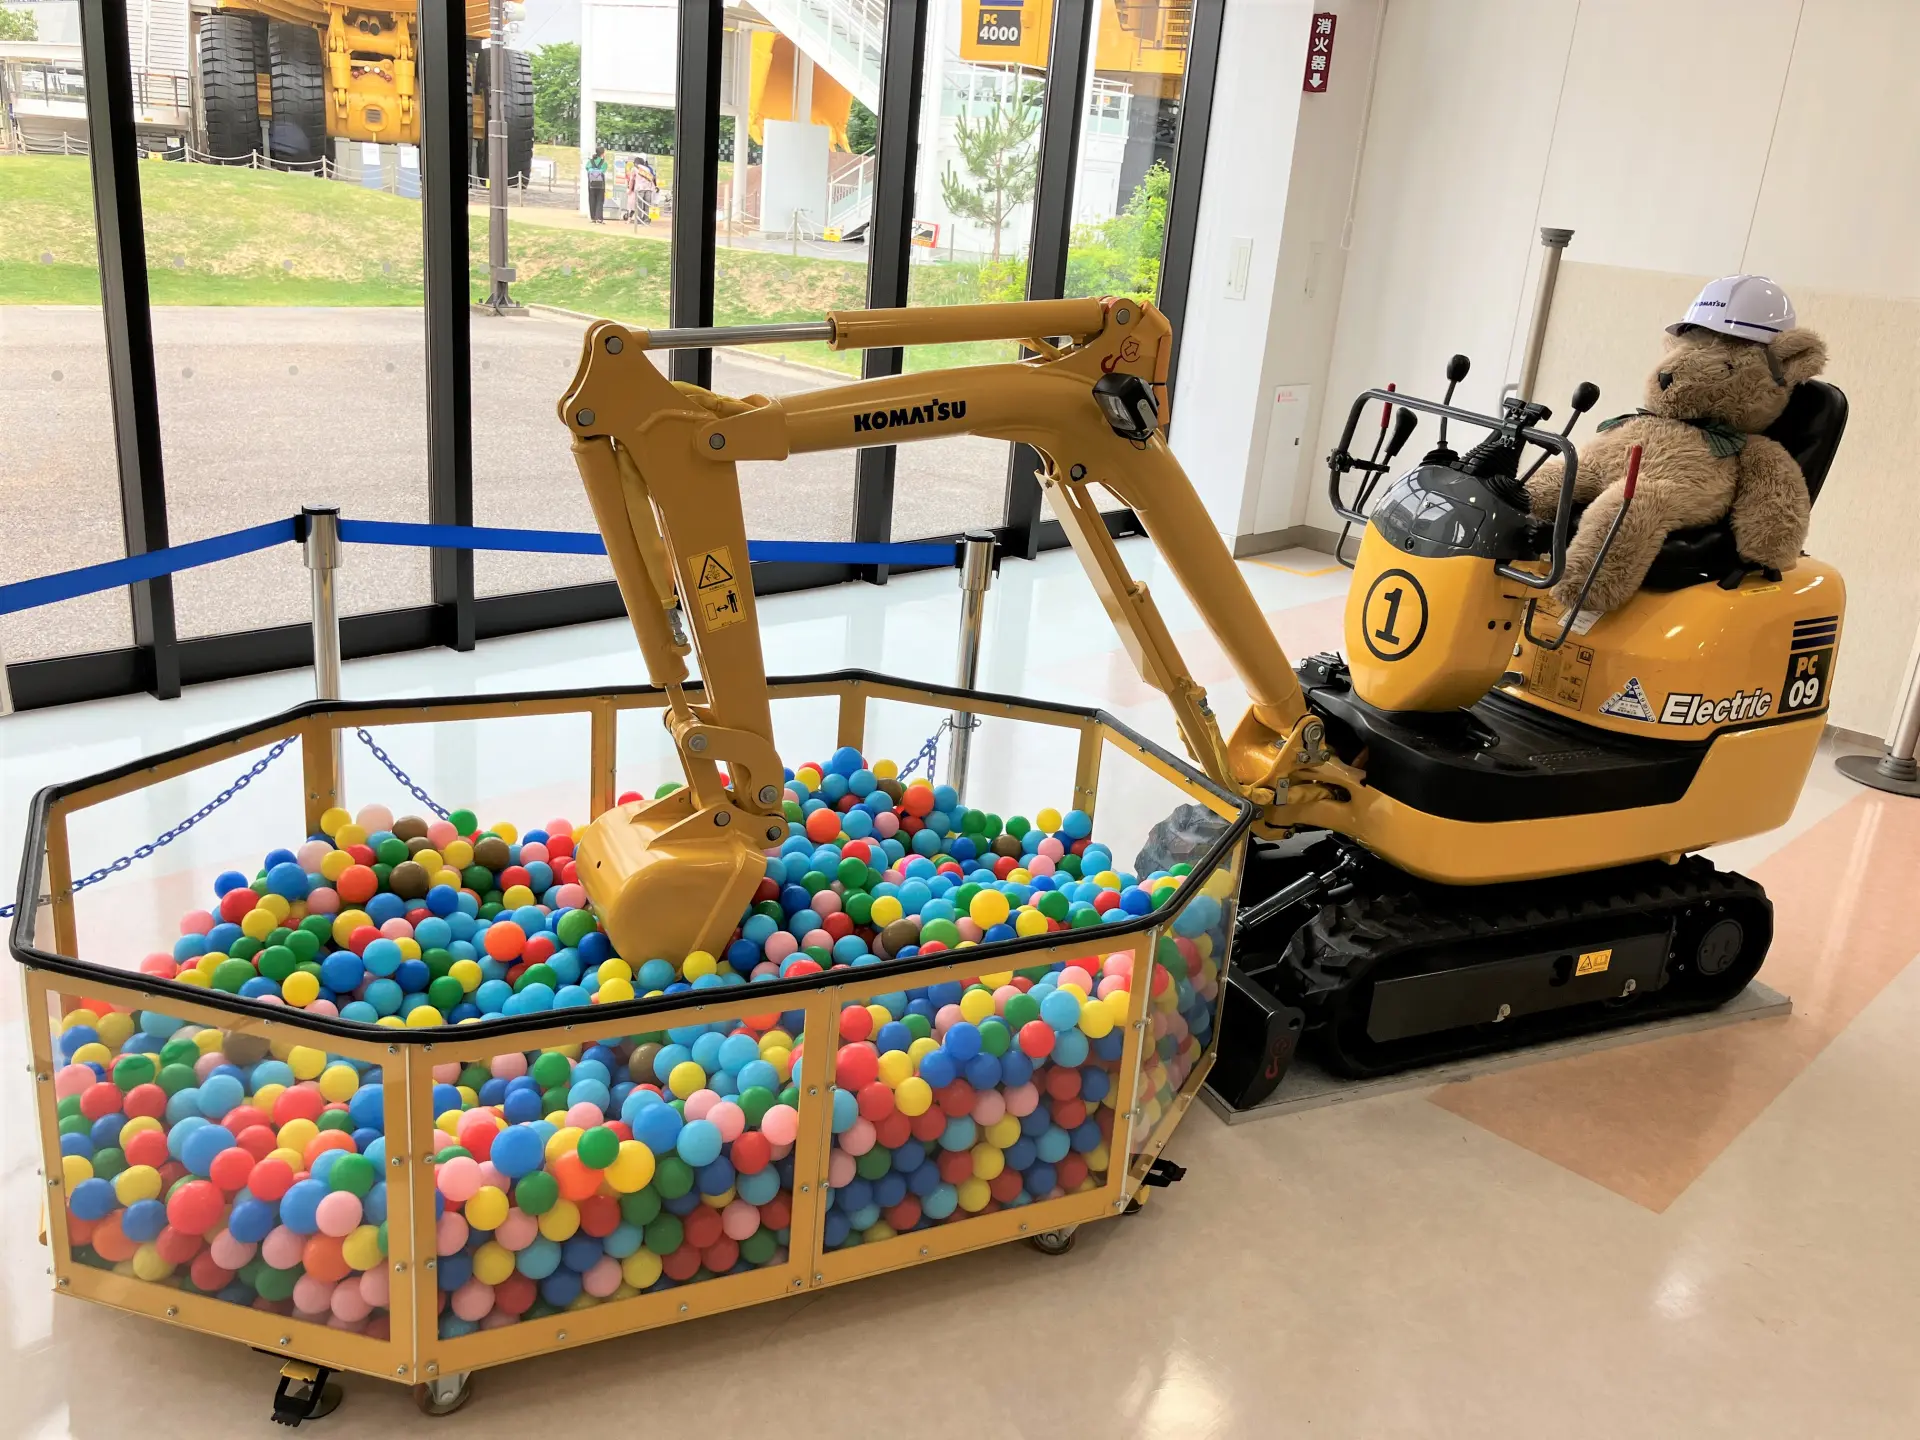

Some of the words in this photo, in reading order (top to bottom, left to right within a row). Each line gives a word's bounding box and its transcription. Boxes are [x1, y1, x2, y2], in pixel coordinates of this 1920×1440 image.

[979, 26, 1018, 41] 4000
[982, 13, 998, 25] PC
[1311, 18, 1332, 71] 消火器
[853, 398, 966, 432] KOMATSU
[1795, 655, 1818, 677] PC
[1659, 687, 1772, 726] Electric
[1788, 677, 1820, 708] 09
